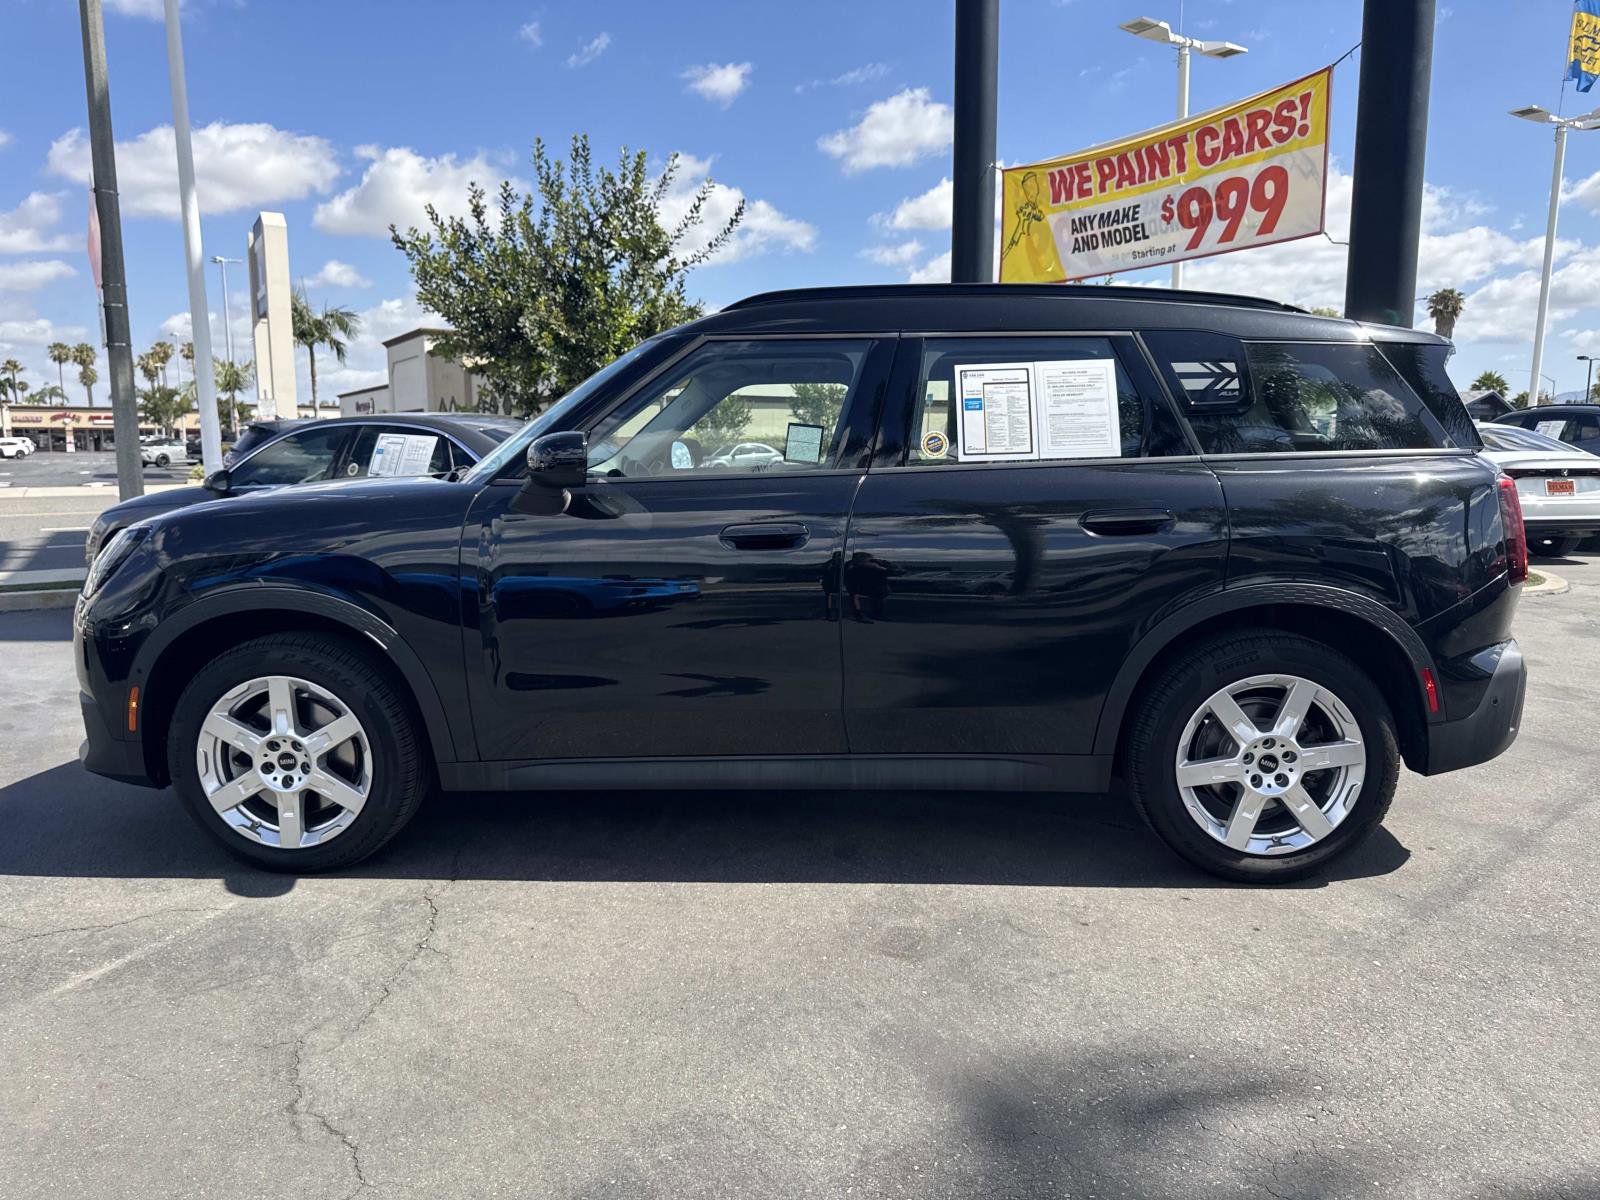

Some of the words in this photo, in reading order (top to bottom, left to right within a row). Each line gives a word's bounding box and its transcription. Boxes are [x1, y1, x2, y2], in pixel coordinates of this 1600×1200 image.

[1047, 162, 1093, 205] WE
[1094, 134, 1189, 194] PAINT
[1195, 91, 1312, 167] CARS!
[1071, 214, 1098, 235] ANY
[1097, 204, 1141, 230] MAKE
[1161, 165, 1289, 252] $999
[1071, 234, 1099, 254] AND
[1100, 222, 1150, 249] MODEL
[1131, 245, 1166, 260] Starting
[1167, 244, 1176, 254] at
[1260, 758, 1277, 769] MINI
